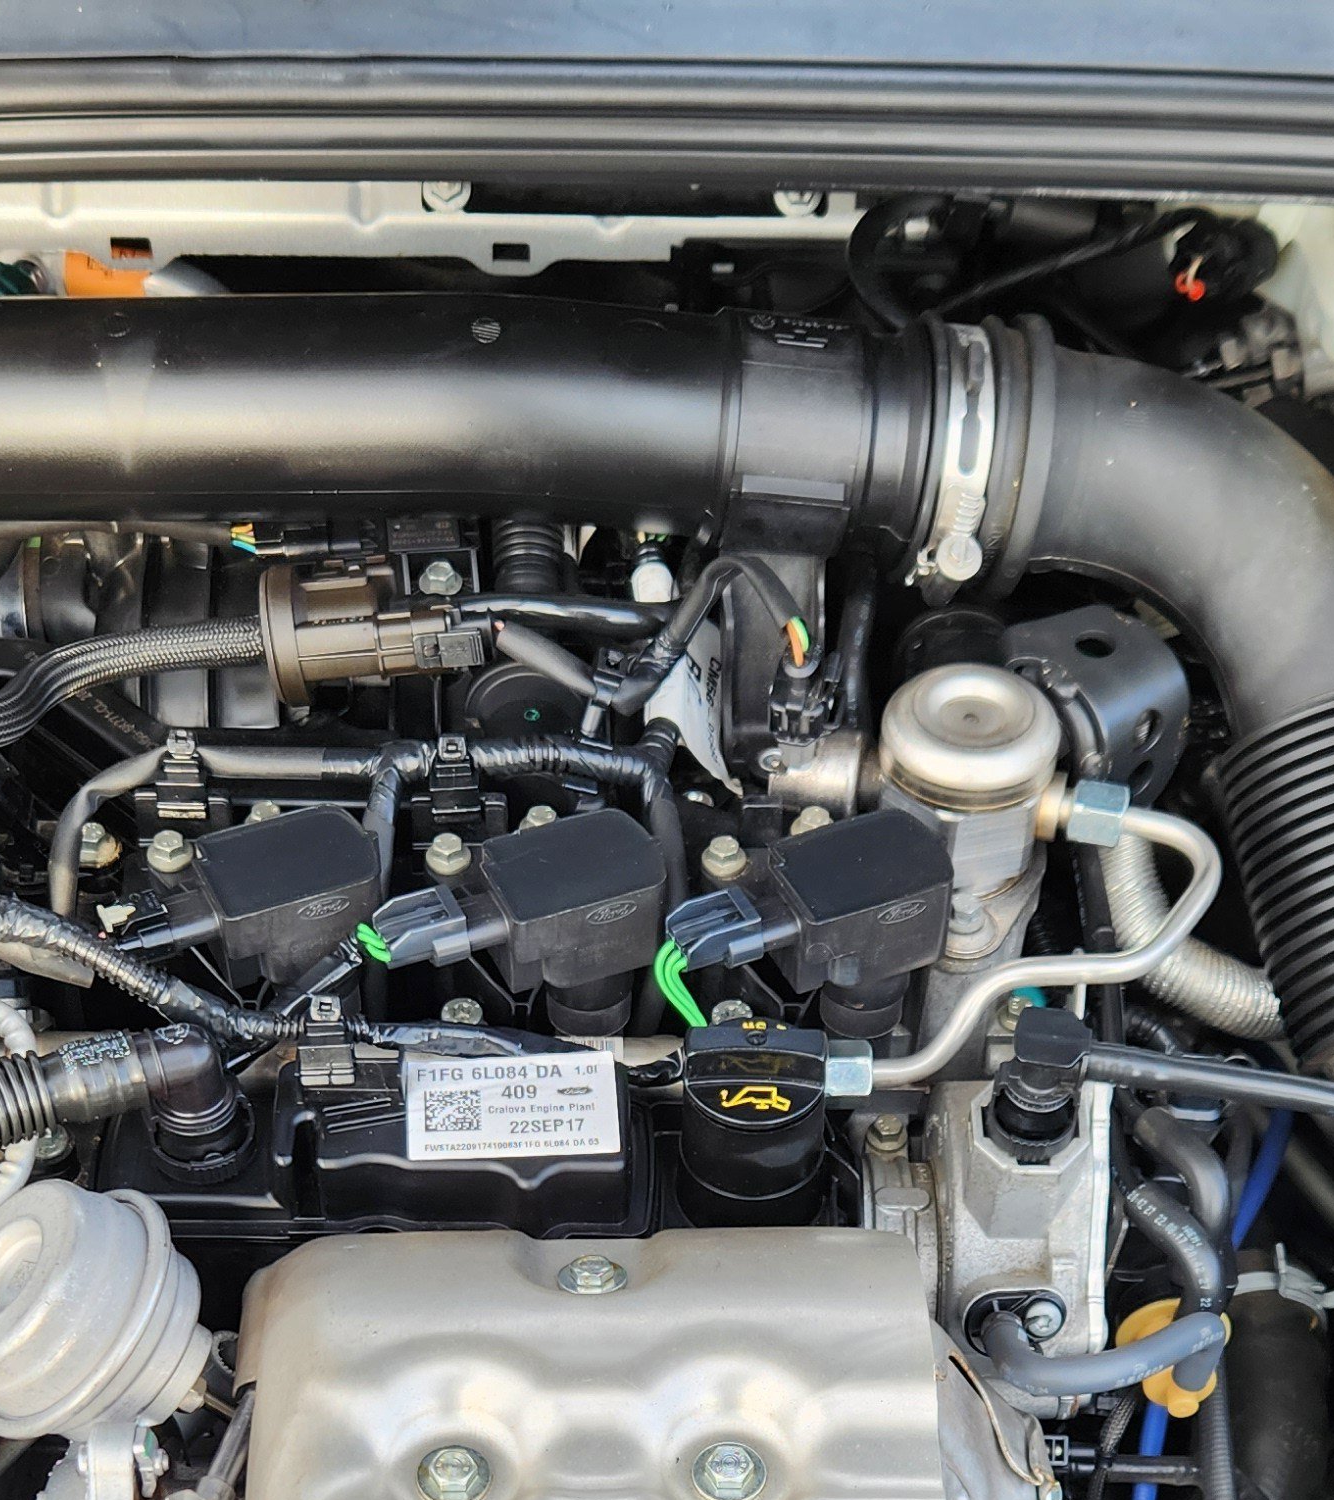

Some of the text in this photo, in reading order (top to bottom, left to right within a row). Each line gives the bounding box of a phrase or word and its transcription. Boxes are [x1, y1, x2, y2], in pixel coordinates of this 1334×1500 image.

[591, 902, 633, 922] Ford
[417, 1068, 464, 1082] F1FG
[471, 1066, 528, 1080] 6L084
[536, 1064, 562, 1078] DA
[501, 1084, 538, 1099] 409
[529, 1103, 565, 1114] Engine
[569, 1101, 596, 1112] Plant
